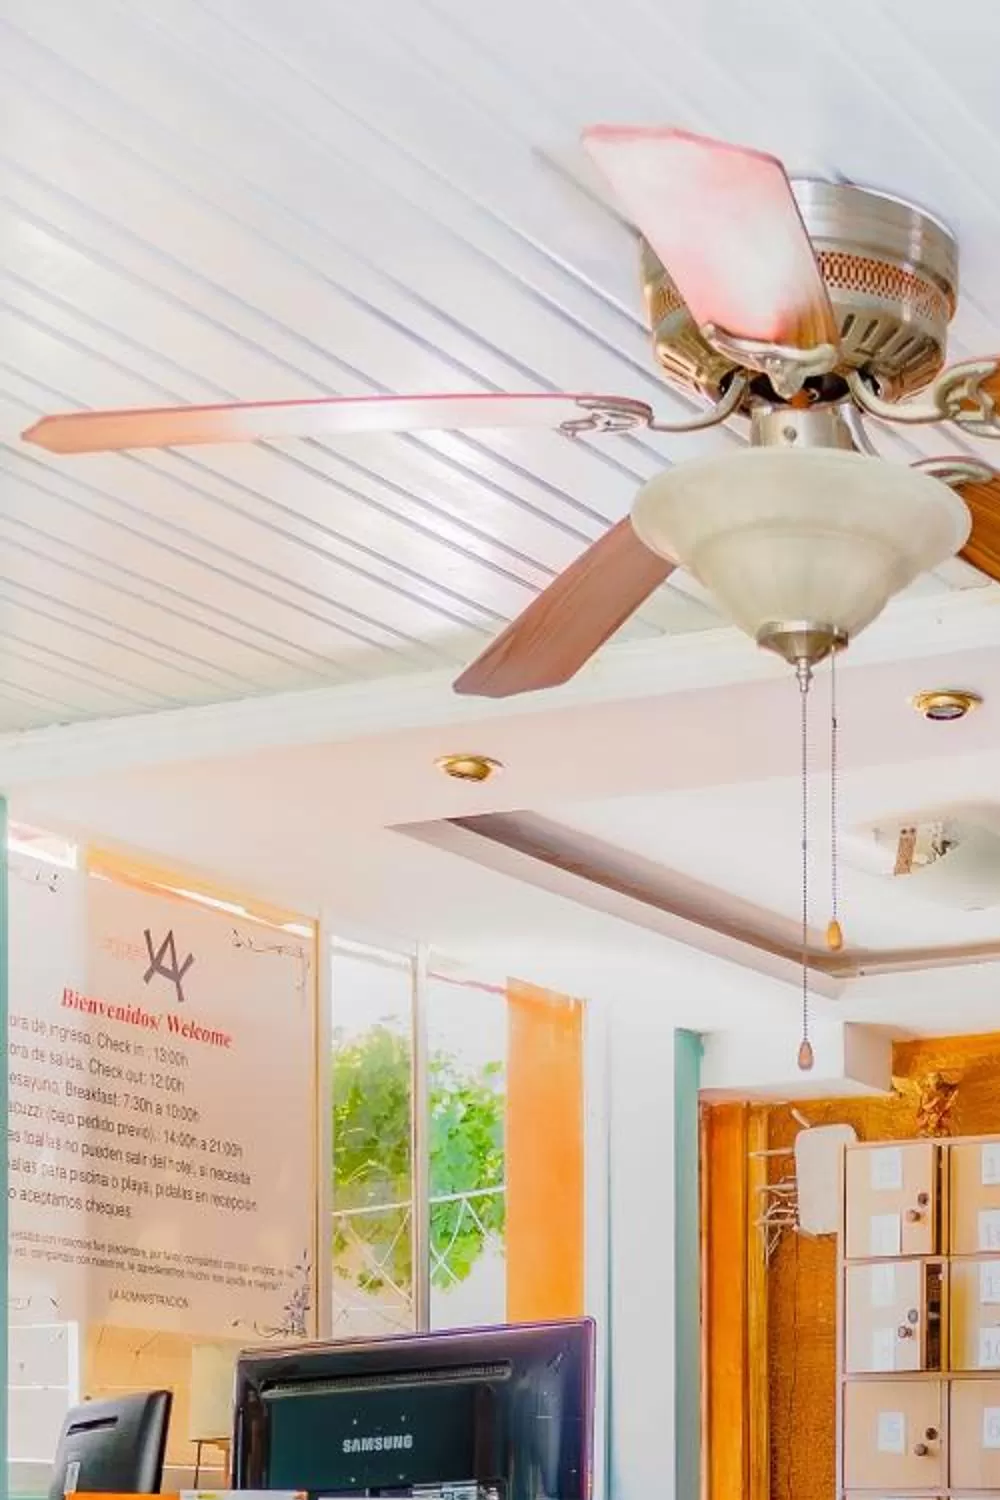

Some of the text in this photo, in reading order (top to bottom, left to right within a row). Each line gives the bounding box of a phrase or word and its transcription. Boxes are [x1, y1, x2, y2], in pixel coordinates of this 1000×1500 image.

[96, 1031, 131, 1054] Check
[167, 1014, 233, 1049] Welcome
[88, 1057, 124, 1080] Check
[342, 1434, 413, 1453] SAMSUNG
